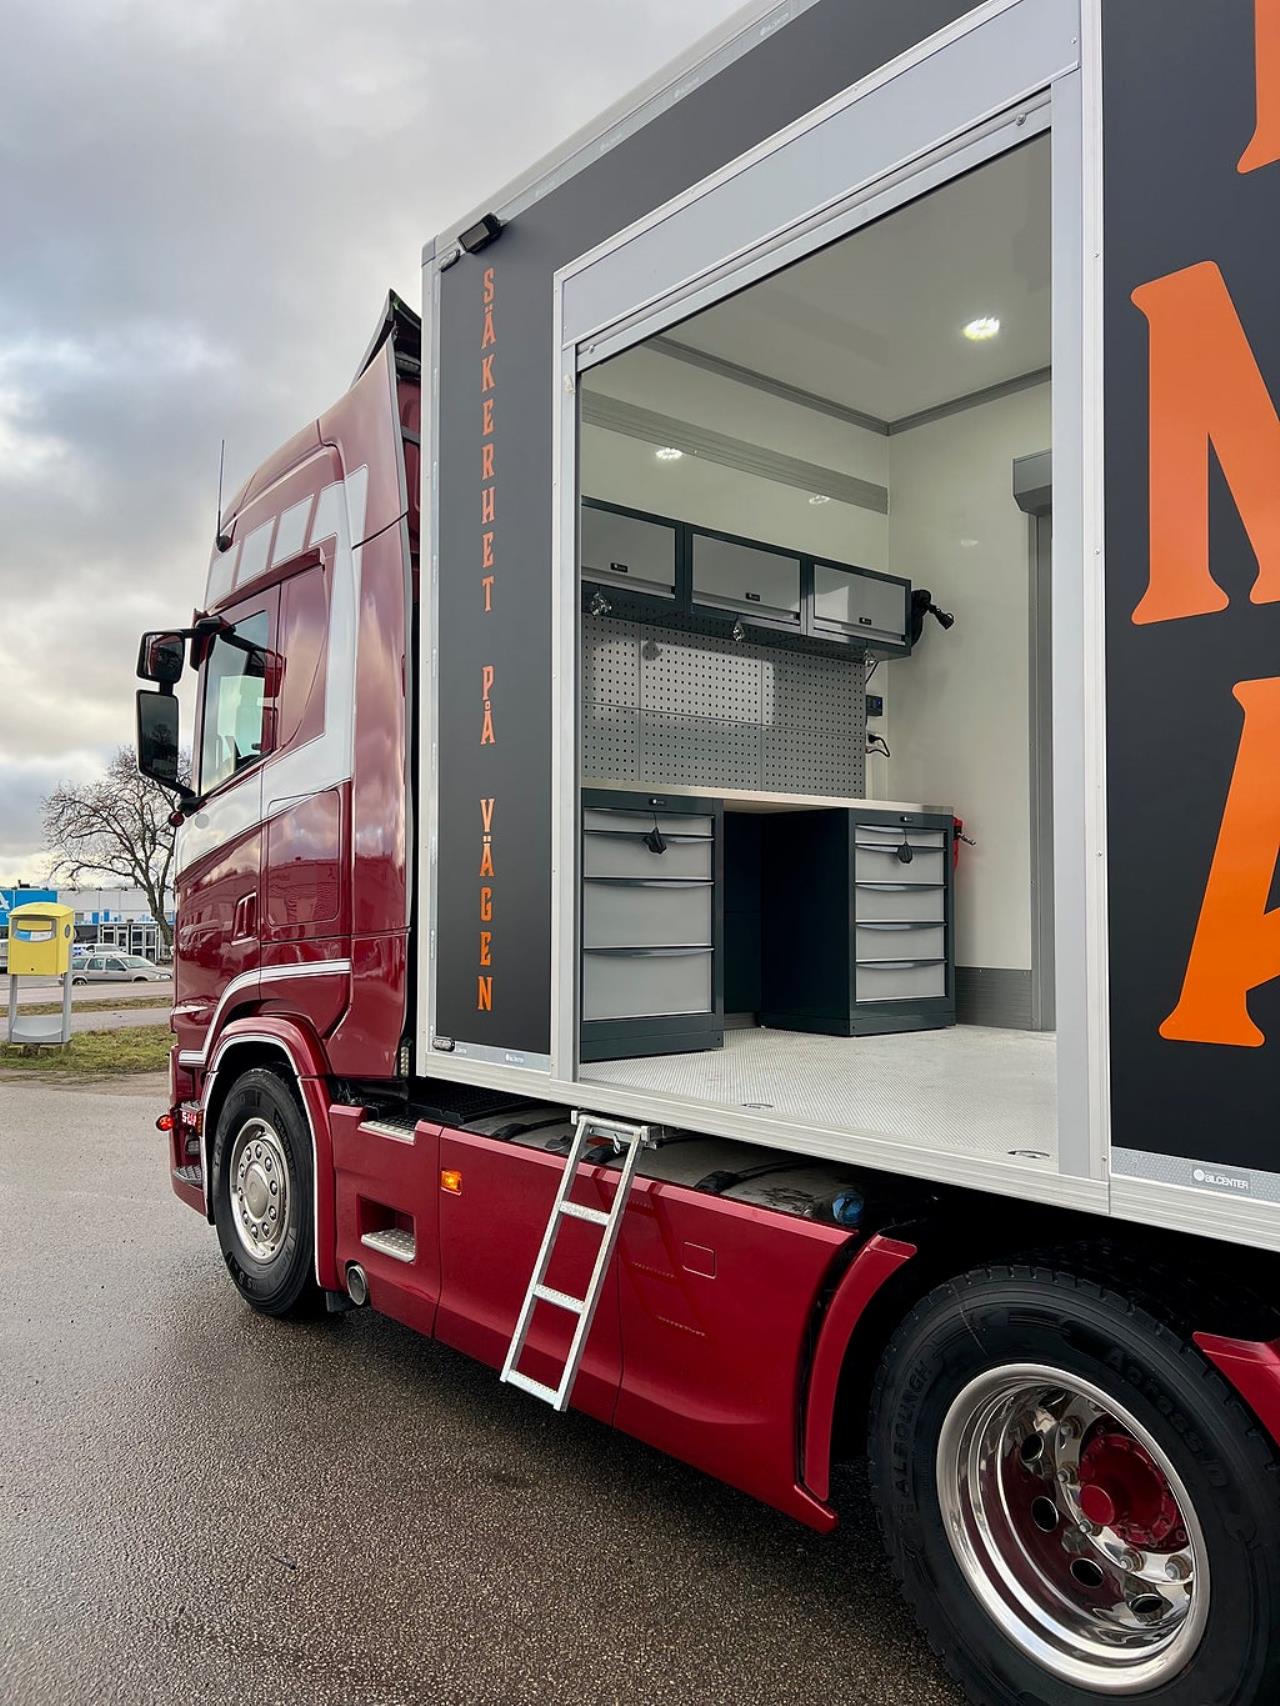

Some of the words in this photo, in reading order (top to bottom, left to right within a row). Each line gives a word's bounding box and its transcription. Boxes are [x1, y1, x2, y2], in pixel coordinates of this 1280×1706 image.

[481, 269, 496, 611] SÄKERHET
[481, 666, 495, 745] PÅ
[476, 799, 495, 1012] VÄGEN
